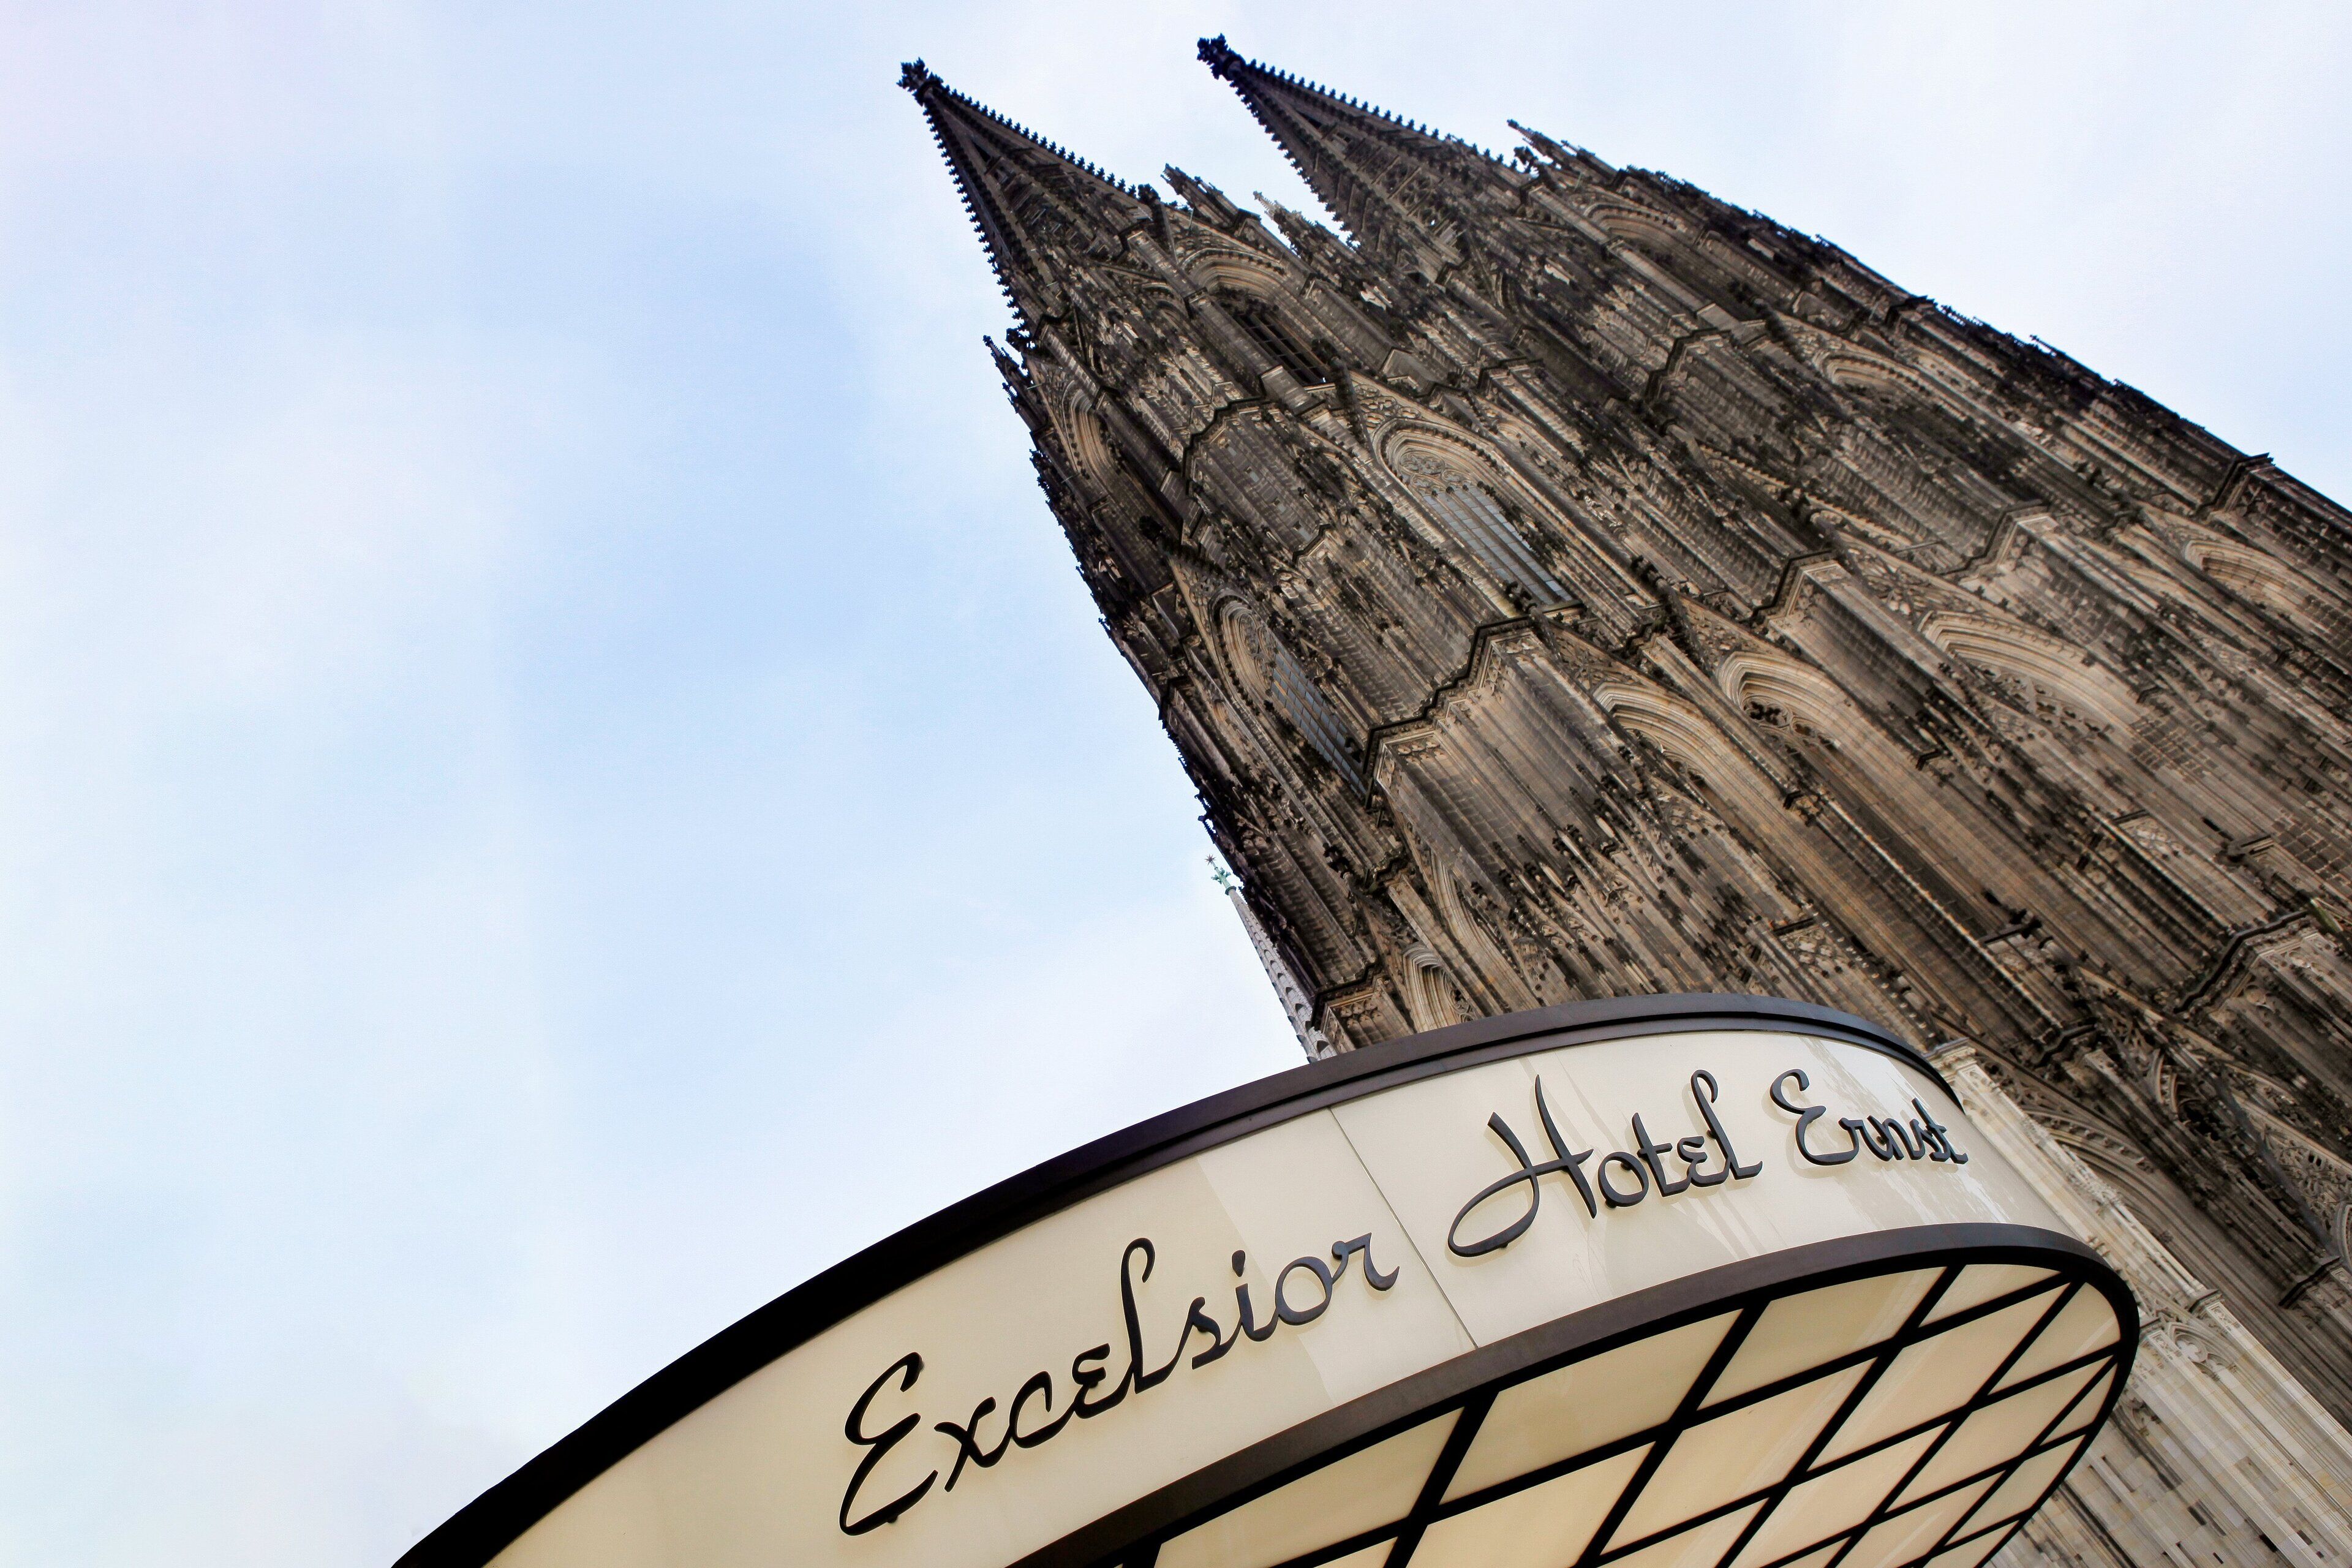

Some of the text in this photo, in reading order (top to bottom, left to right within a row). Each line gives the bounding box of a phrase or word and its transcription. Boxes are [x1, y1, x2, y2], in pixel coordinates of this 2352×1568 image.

[839, 1068, 1968, 1536] Excelsior Hotel Ernst
